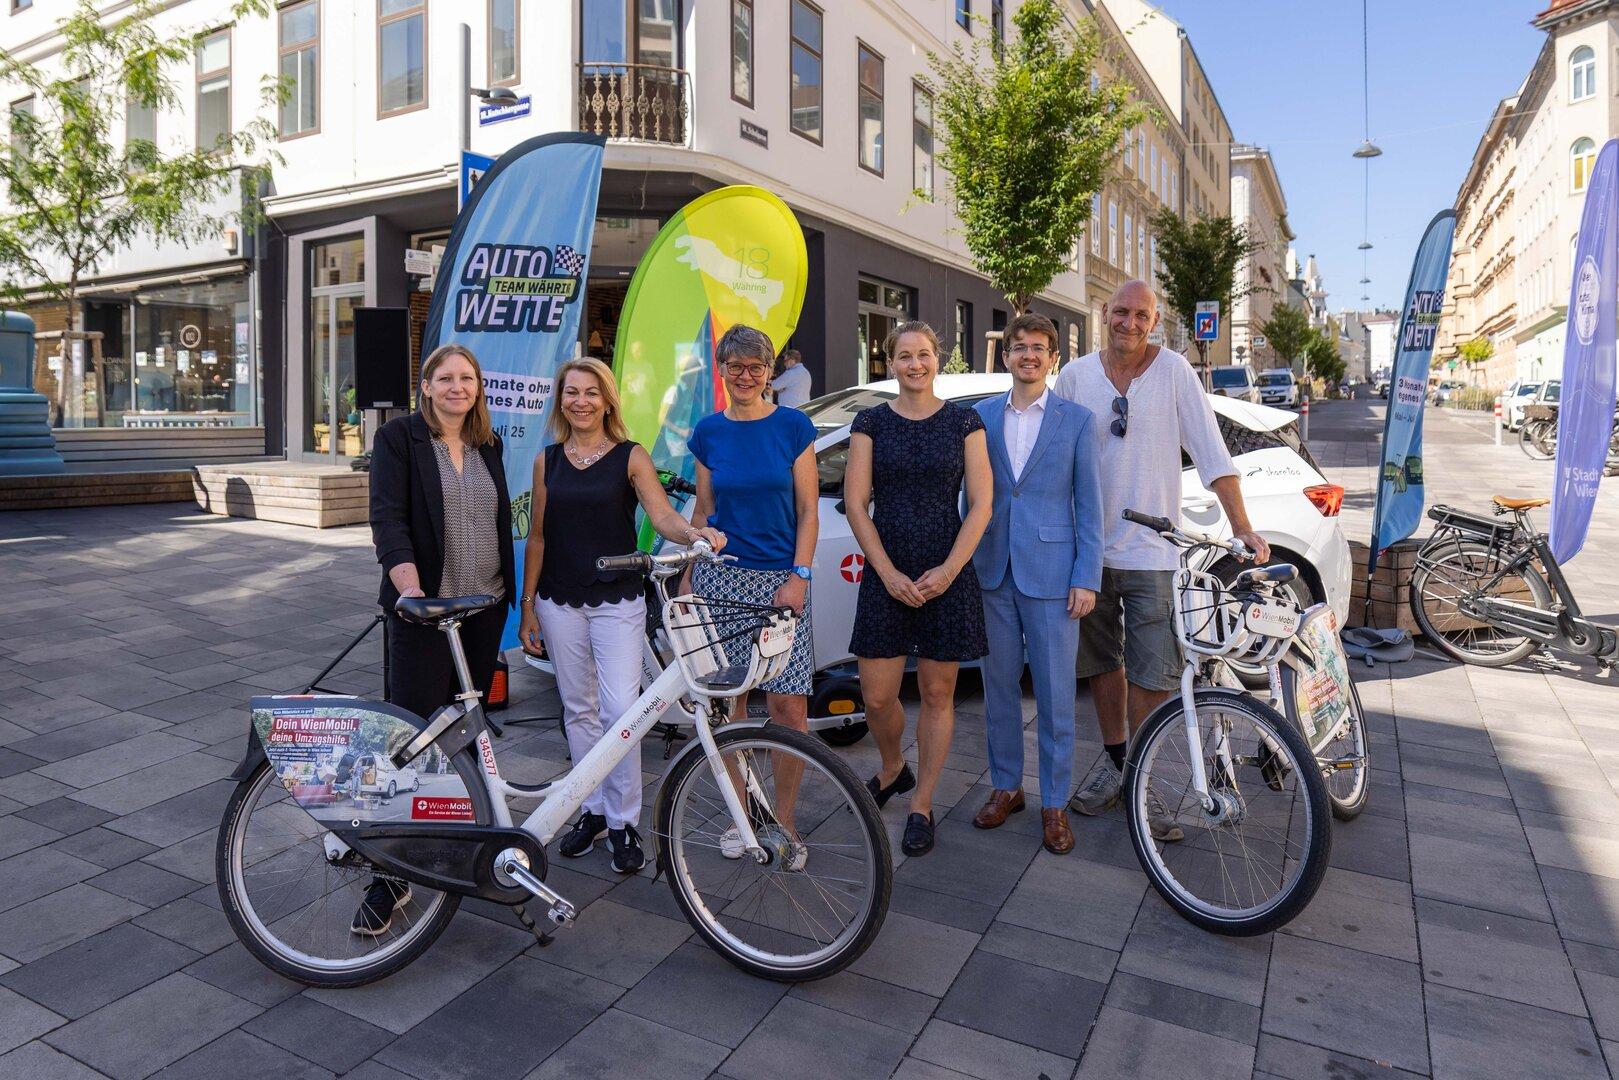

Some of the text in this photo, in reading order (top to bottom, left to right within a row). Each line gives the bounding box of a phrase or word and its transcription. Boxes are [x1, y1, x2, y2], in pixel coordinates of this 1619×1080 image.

[466, 247, 548, 279] AUTO
[734, 247, 769, 279] 18
[495, 280, 526, 293] TEAM
[459, 293, 566, 326] WETTE
[482, 377, 525, 392] onate
[515, 395, 544, 410] Auto
[491, 425, 526, 438] uli 25
[1572, 467, 1600, 481] Stadt
[628, 695, 662, 731] WienMobil
[276, 718, 357, 731] Dein WienMobil,
[271, 732, 347, 745] deine Umzugshilfe.
[479, 737, 497, 776] 345377
[428, 802, 472, 810] WienMobil
